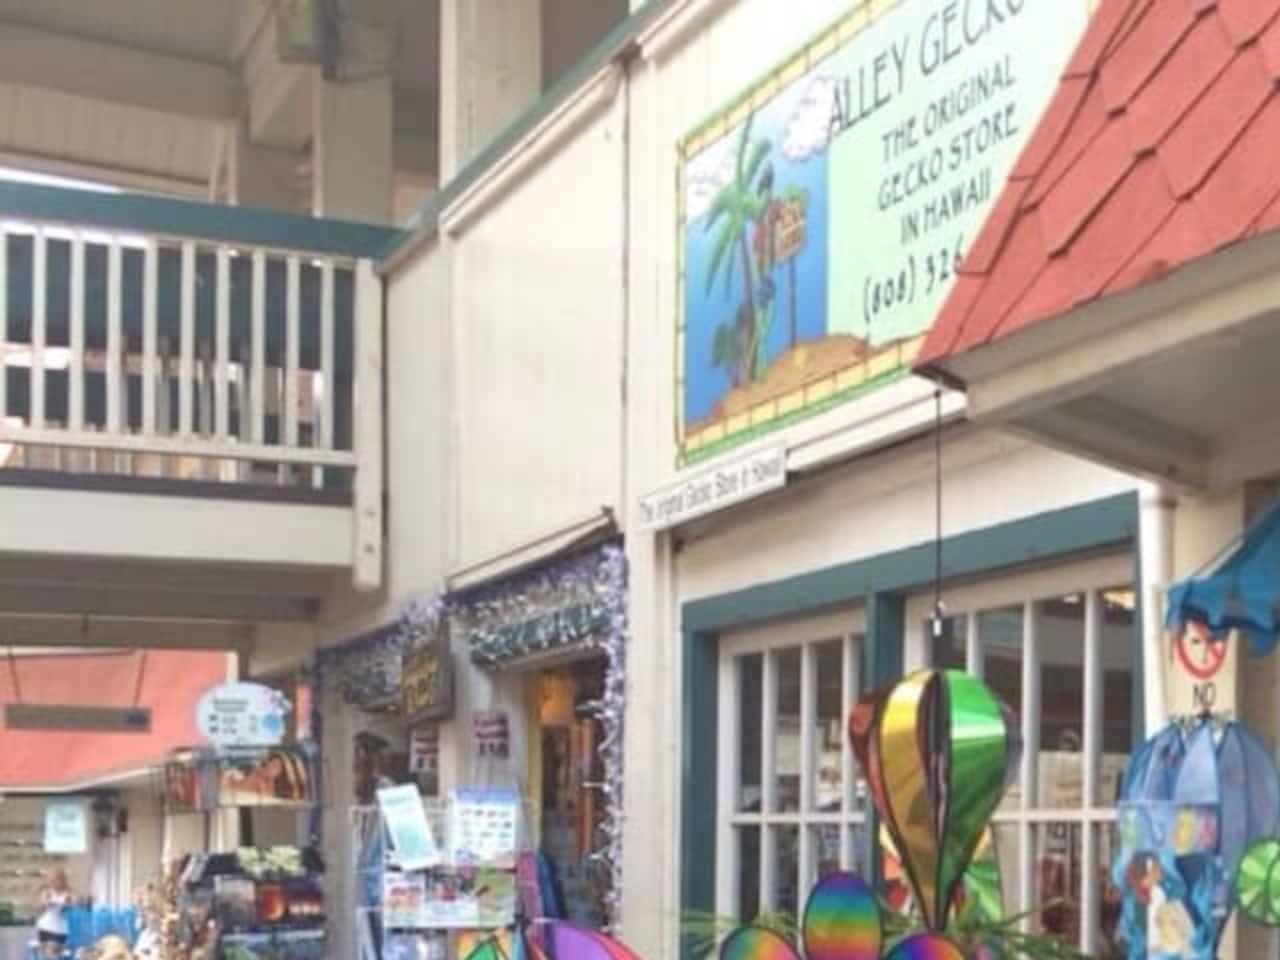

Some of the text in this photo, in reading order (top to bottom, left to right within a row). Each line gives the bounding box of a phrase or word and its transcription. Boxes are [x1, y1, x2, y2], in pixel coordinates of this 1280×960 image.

[827, 0, 1025, 141] ALLEY GECK
[881, 53, 1017, 161] THE ORIGINAL
[878, 101, 1019, 212] GECKO STORE
[901, 167, 992, 245] IN HAWAII
[863, 254, 916, 325] (808)
[1192, 682, 1217, 708] NO
